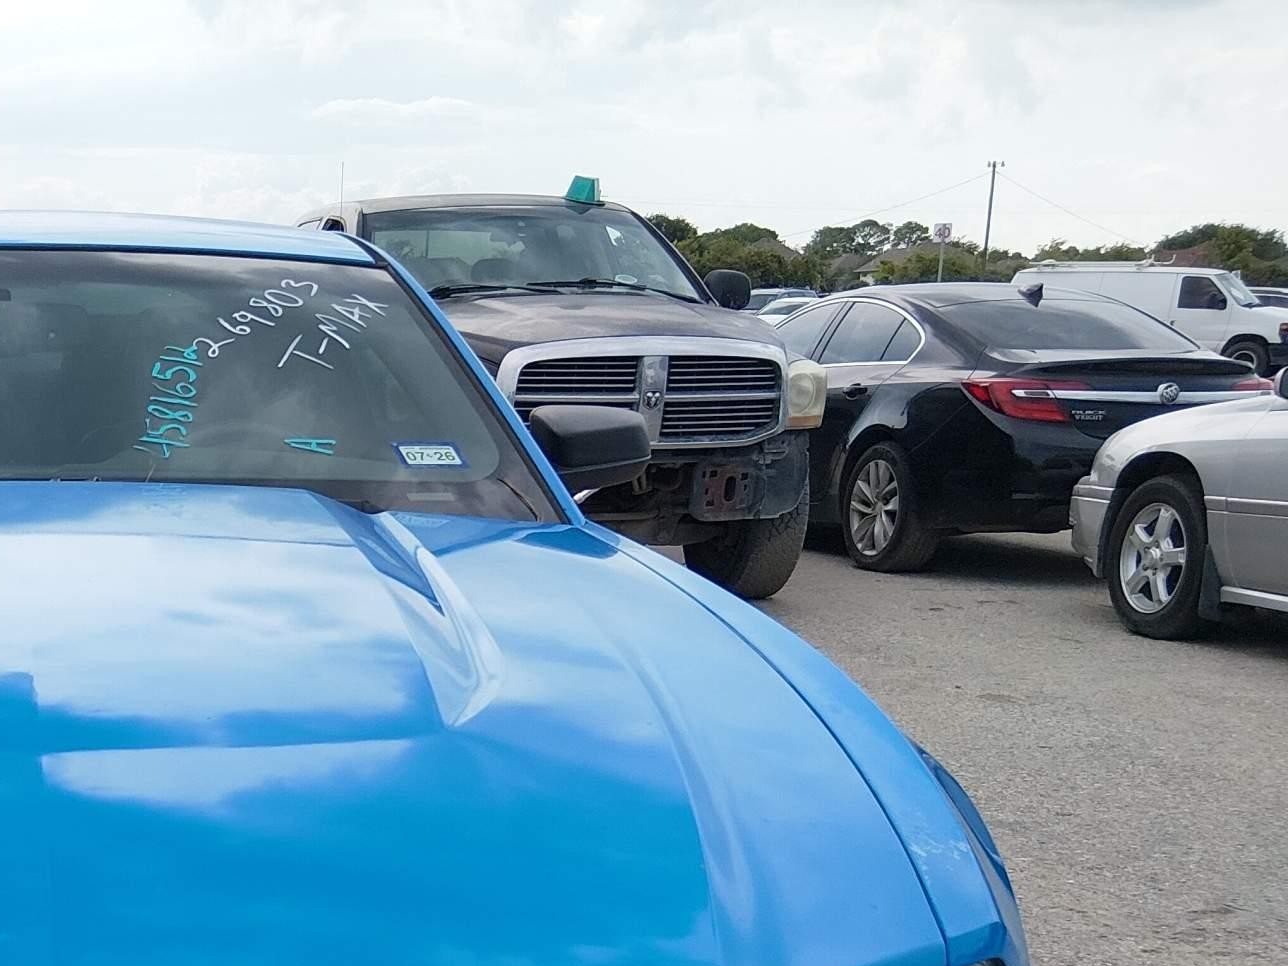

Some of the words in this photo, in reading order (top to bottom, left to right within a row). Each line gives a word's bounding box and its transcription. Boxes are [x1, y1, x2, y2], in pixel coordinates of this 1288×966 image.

[193, 279, 319, 358] 269803
[277, 294, 389, 369] T-MAX
[283, 437, 337, 456] A
